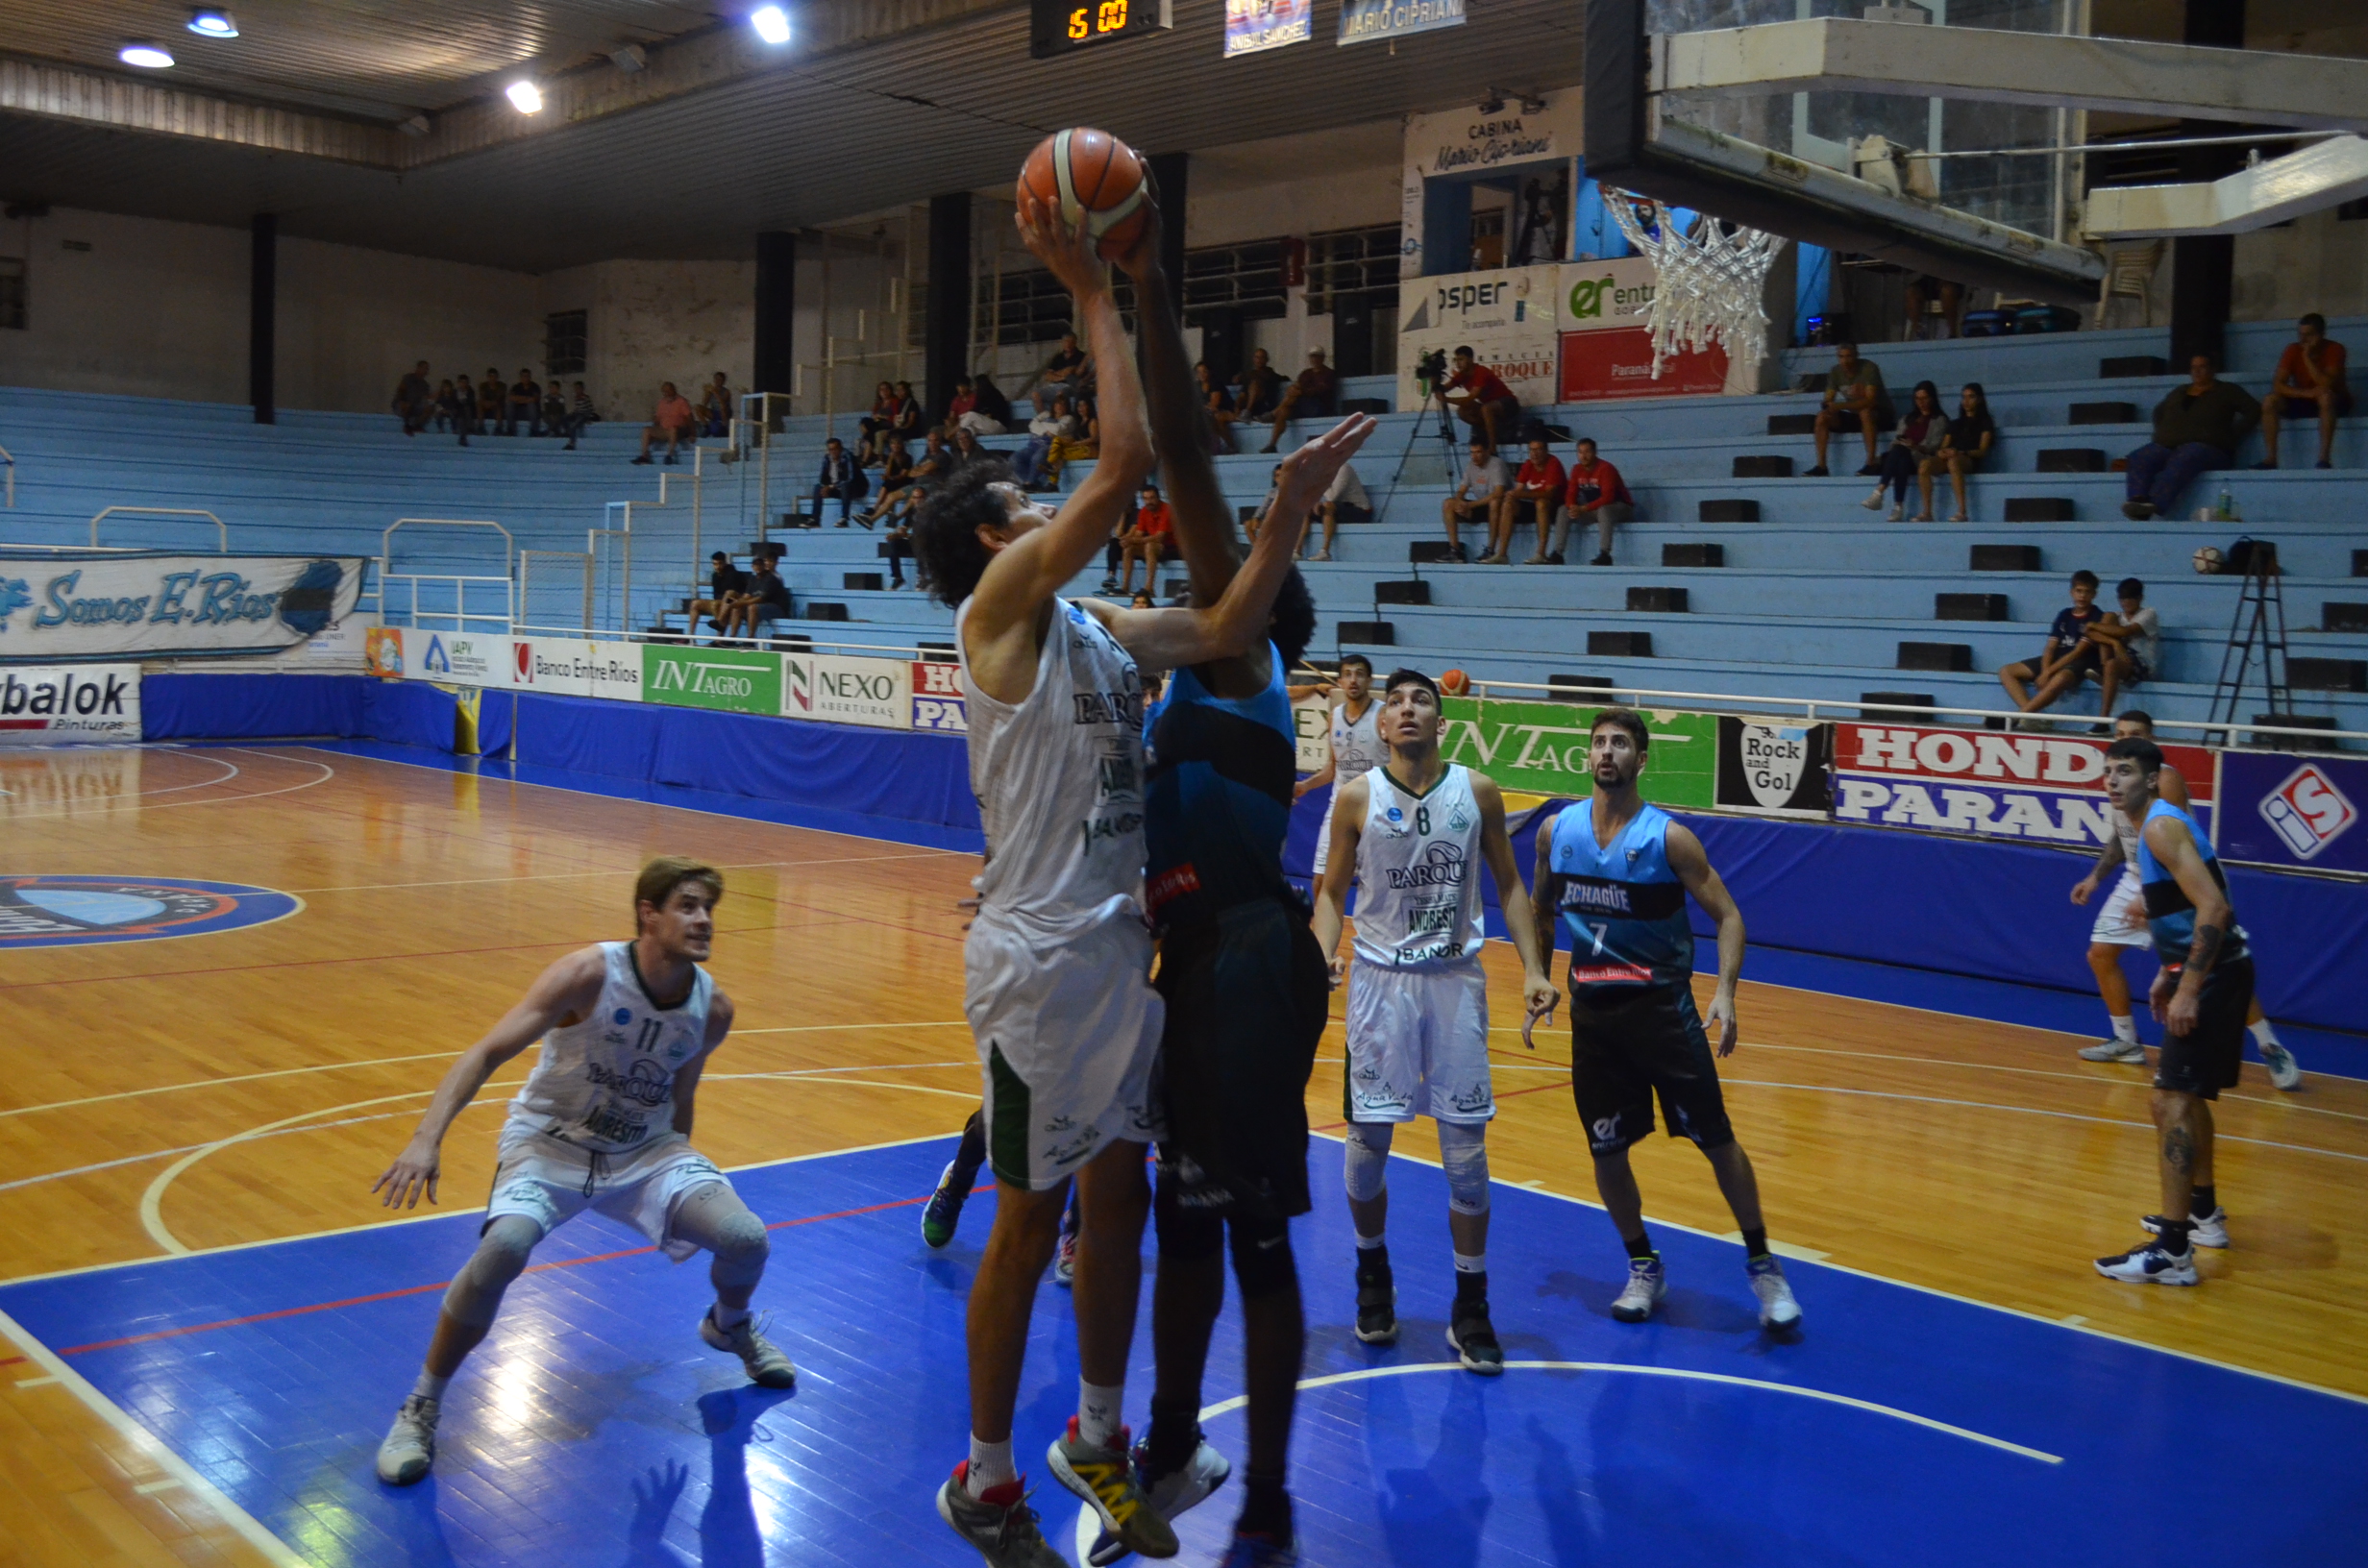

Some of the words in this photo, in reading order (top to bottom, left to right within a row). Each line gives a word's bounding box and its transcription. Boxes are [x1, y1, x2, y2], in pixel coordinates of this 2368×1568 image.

[1468, 118, 1523, 139] CABINA
[35, 569, 151, 628] Somos
[535, 655, 572, 677] Banco
[574, 657, 607, 681] Entre
[820, 672, 894, 701] NEXO
[821, 701, 895, 717] ABERTURAS
[54, 719, 124, 731] Pinturas
[1746, 737, 1801, 759] Rock
[1857, 727, 2107, 783] HOND
[1745, 757, 1770, 769] and
[1755, 770, 1792, 791] Gol
[1416, 806, 1432, 836] 8
[1837, 779, 2115, 849] PARAN
[1589, 922, 1608, 957] 7
[636, 1017, 663, 1053] 11
